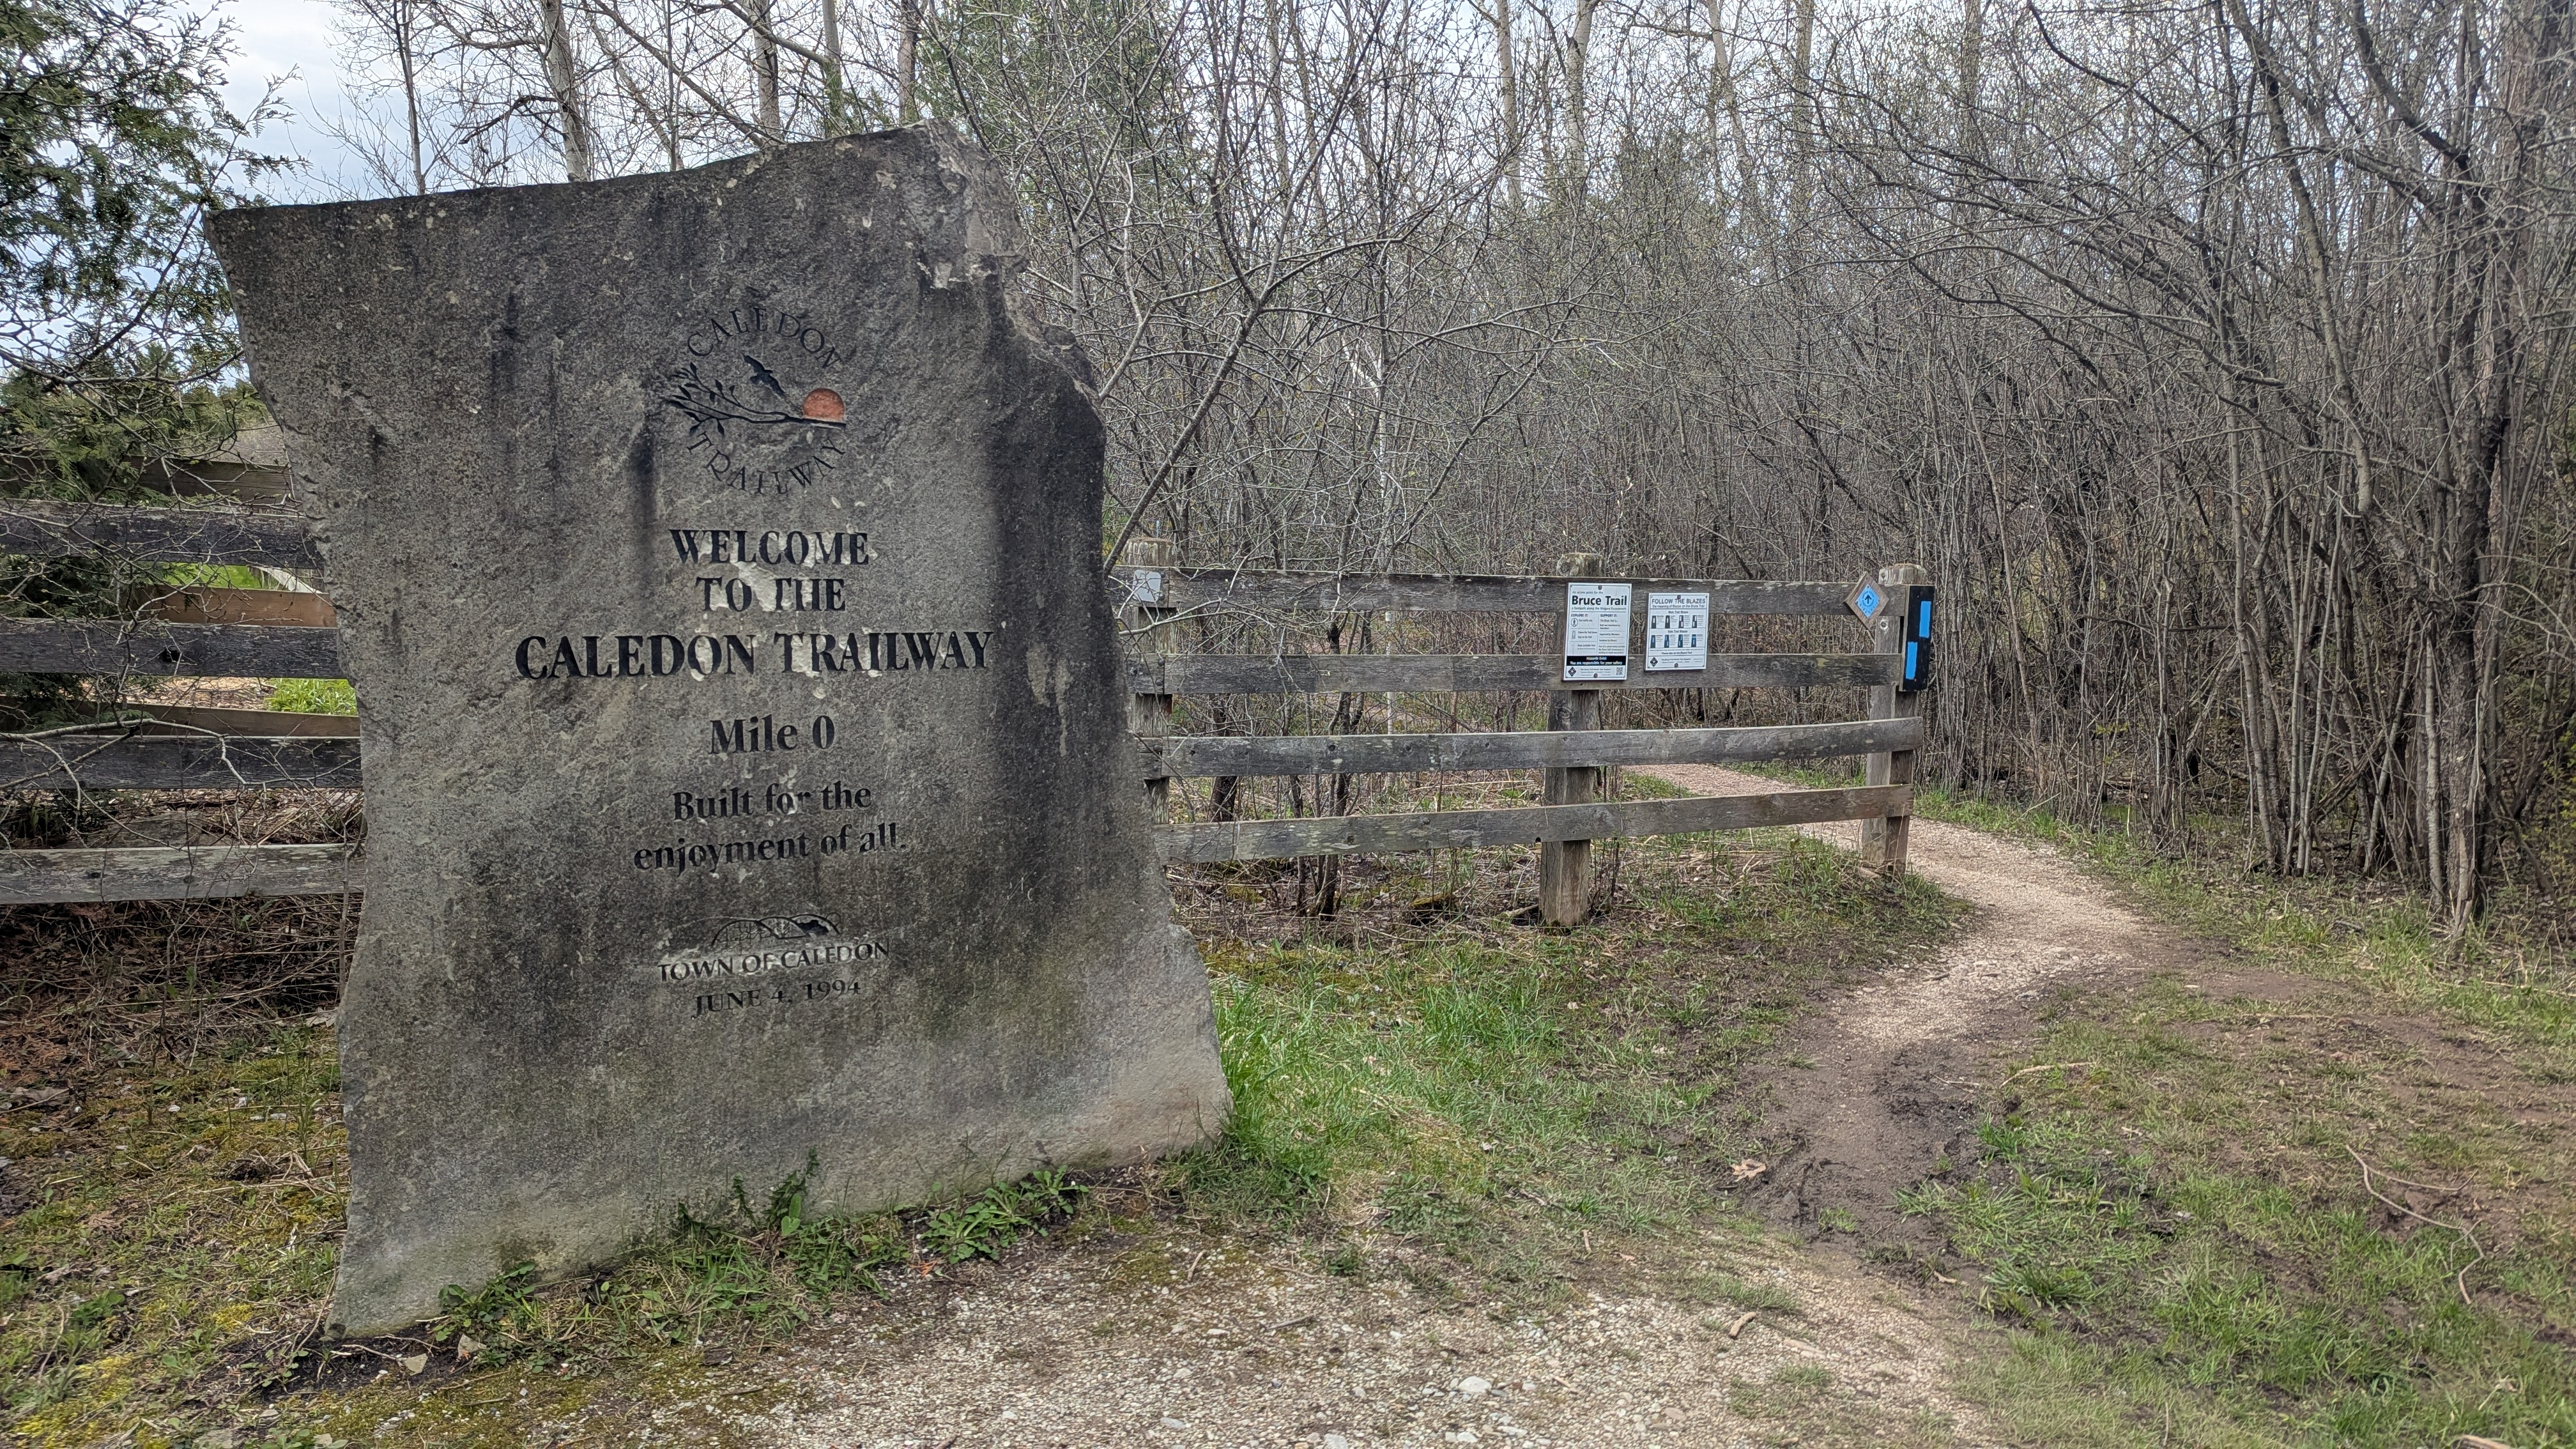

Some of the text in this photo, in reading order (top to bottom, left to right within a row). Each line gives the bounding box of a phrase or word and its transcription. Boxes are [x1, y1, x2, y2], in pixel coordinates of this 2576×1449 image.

[687, 307, 843, 369] CALEDON
[686, 431, 846, 496] TRAILWAY
[668, 529, 869, 565] WELCOME
[696, 577, 847, 612] TO THE
[1572, 595, 1627, 605] Bruce Trail
[516, 631, 994, 679] CALEDON TRAILWAY
[709, 714, 835, 755] Mile 0
[673, 781, 871, 821] Built for the
[634, 822, 907, 877] enjoyment of all.
[657, 942, 889, 982] TOWN OF CALEDON
[691, 989, 762, 1020] JUNE
[804, 979, 861, 1001] 1994
